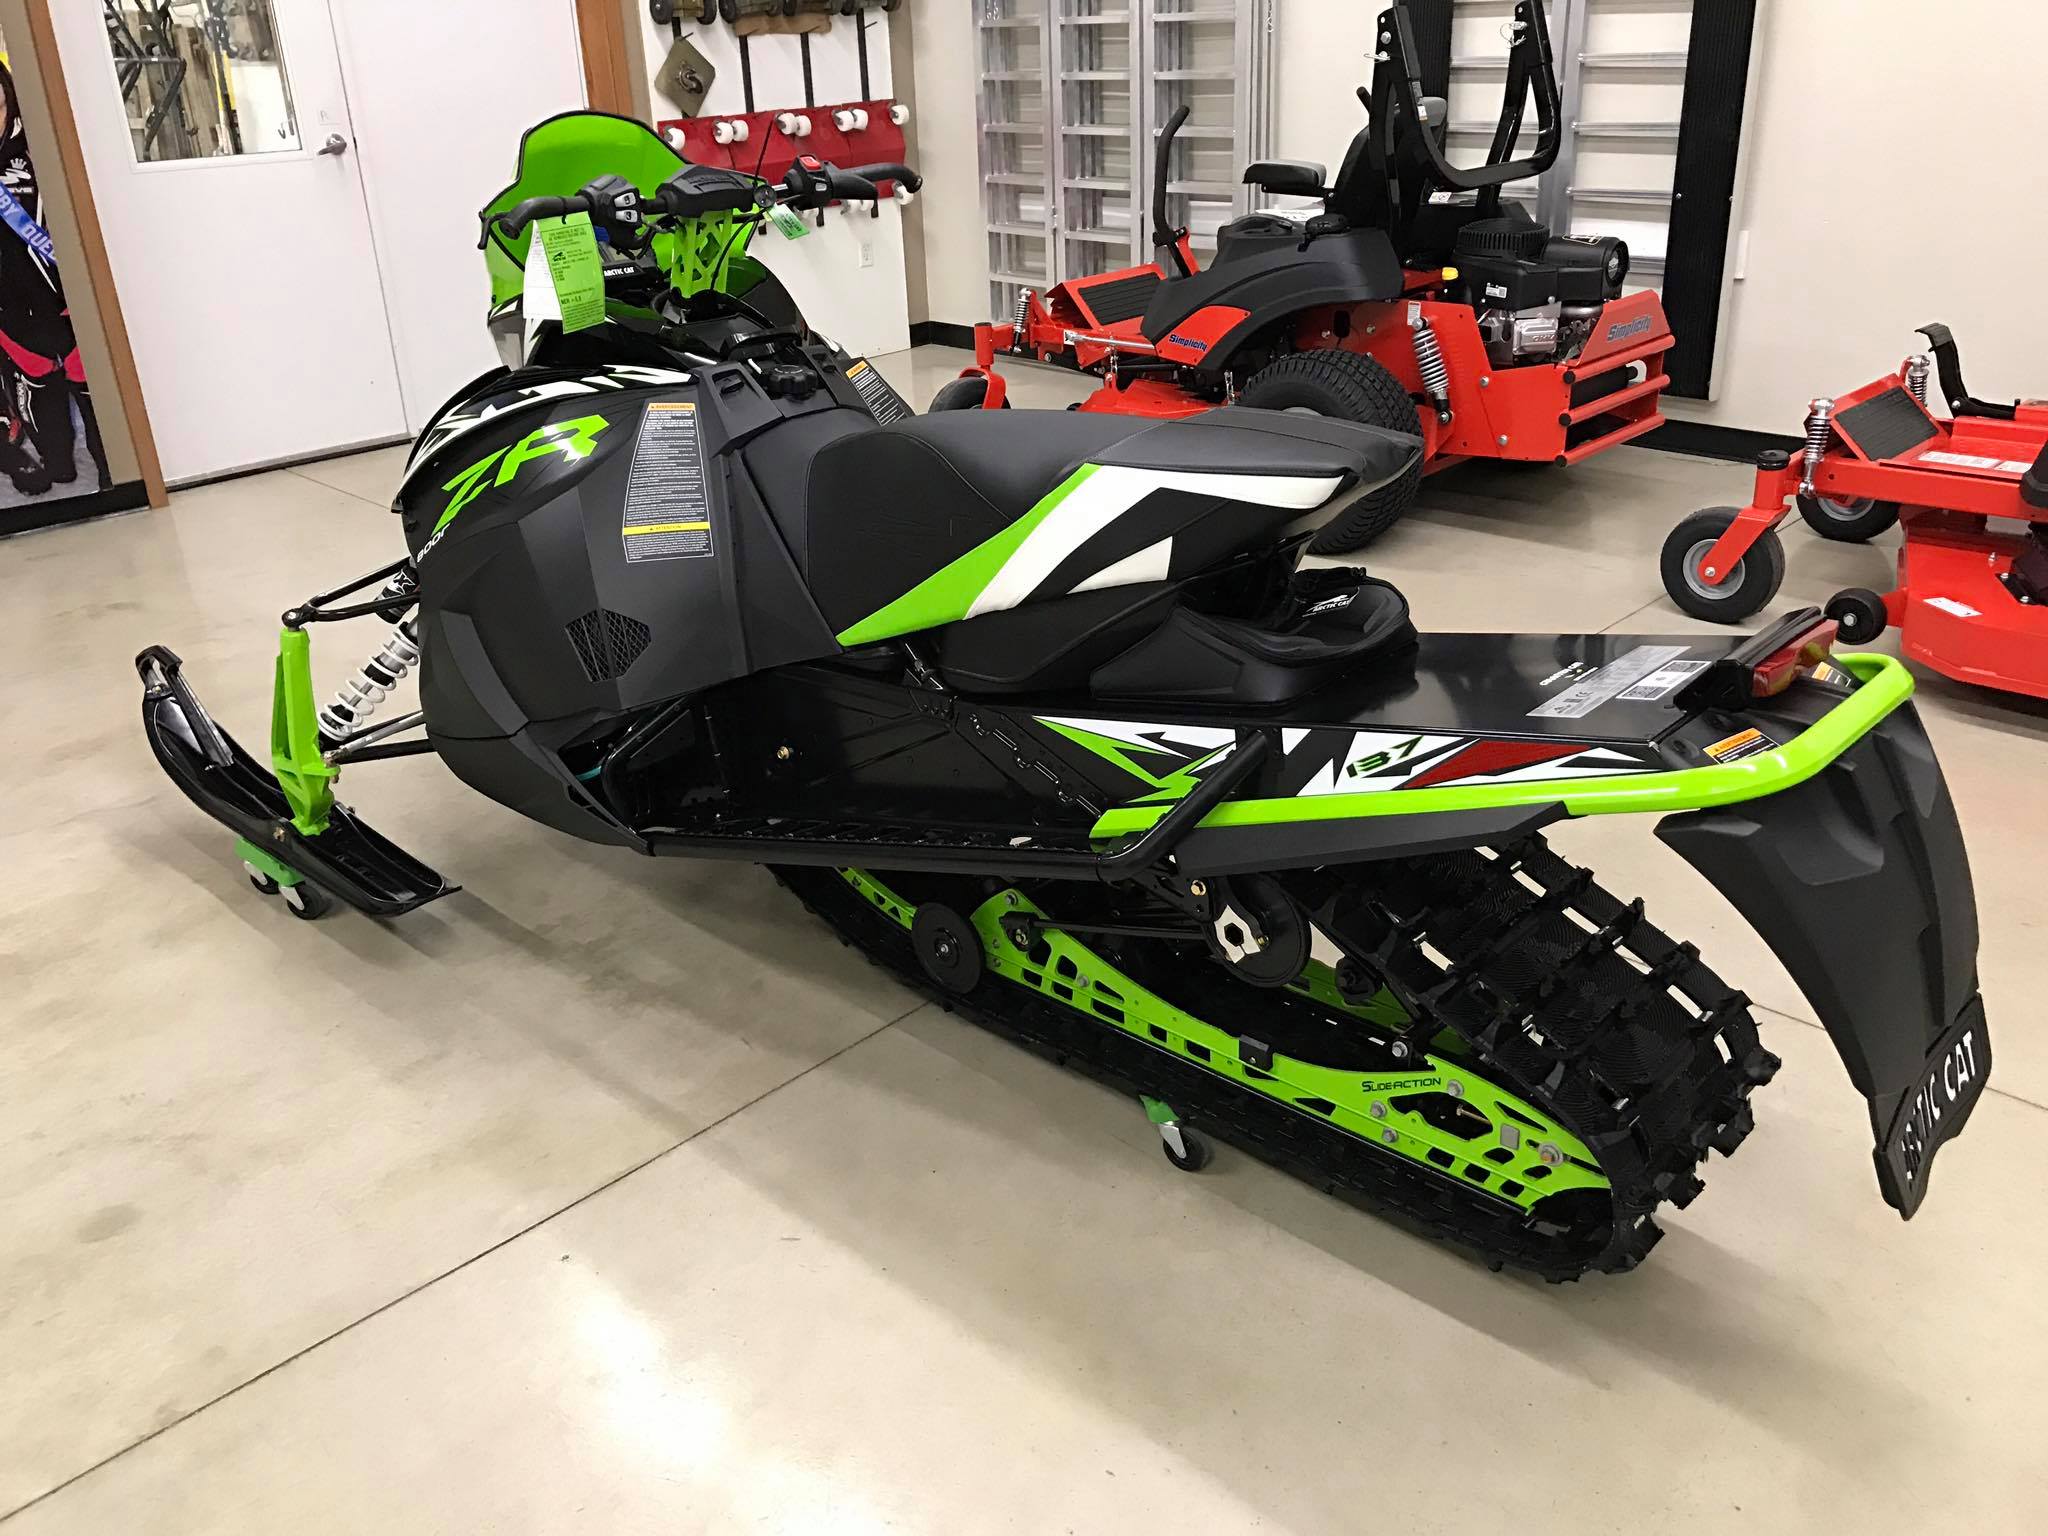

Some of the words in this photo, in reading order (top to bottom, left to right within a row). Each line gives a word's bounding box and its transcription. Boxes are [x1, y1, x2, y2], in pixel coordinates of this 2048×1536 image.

[623, 266, 635, 274] CAT
[1169, 333, 1208, 352] Simplicity
[1607, 314, 1652, 343] Simplicity
[432, 414, 610, 537] ZR
[1943, 1030, 1977, 1103] CAT
